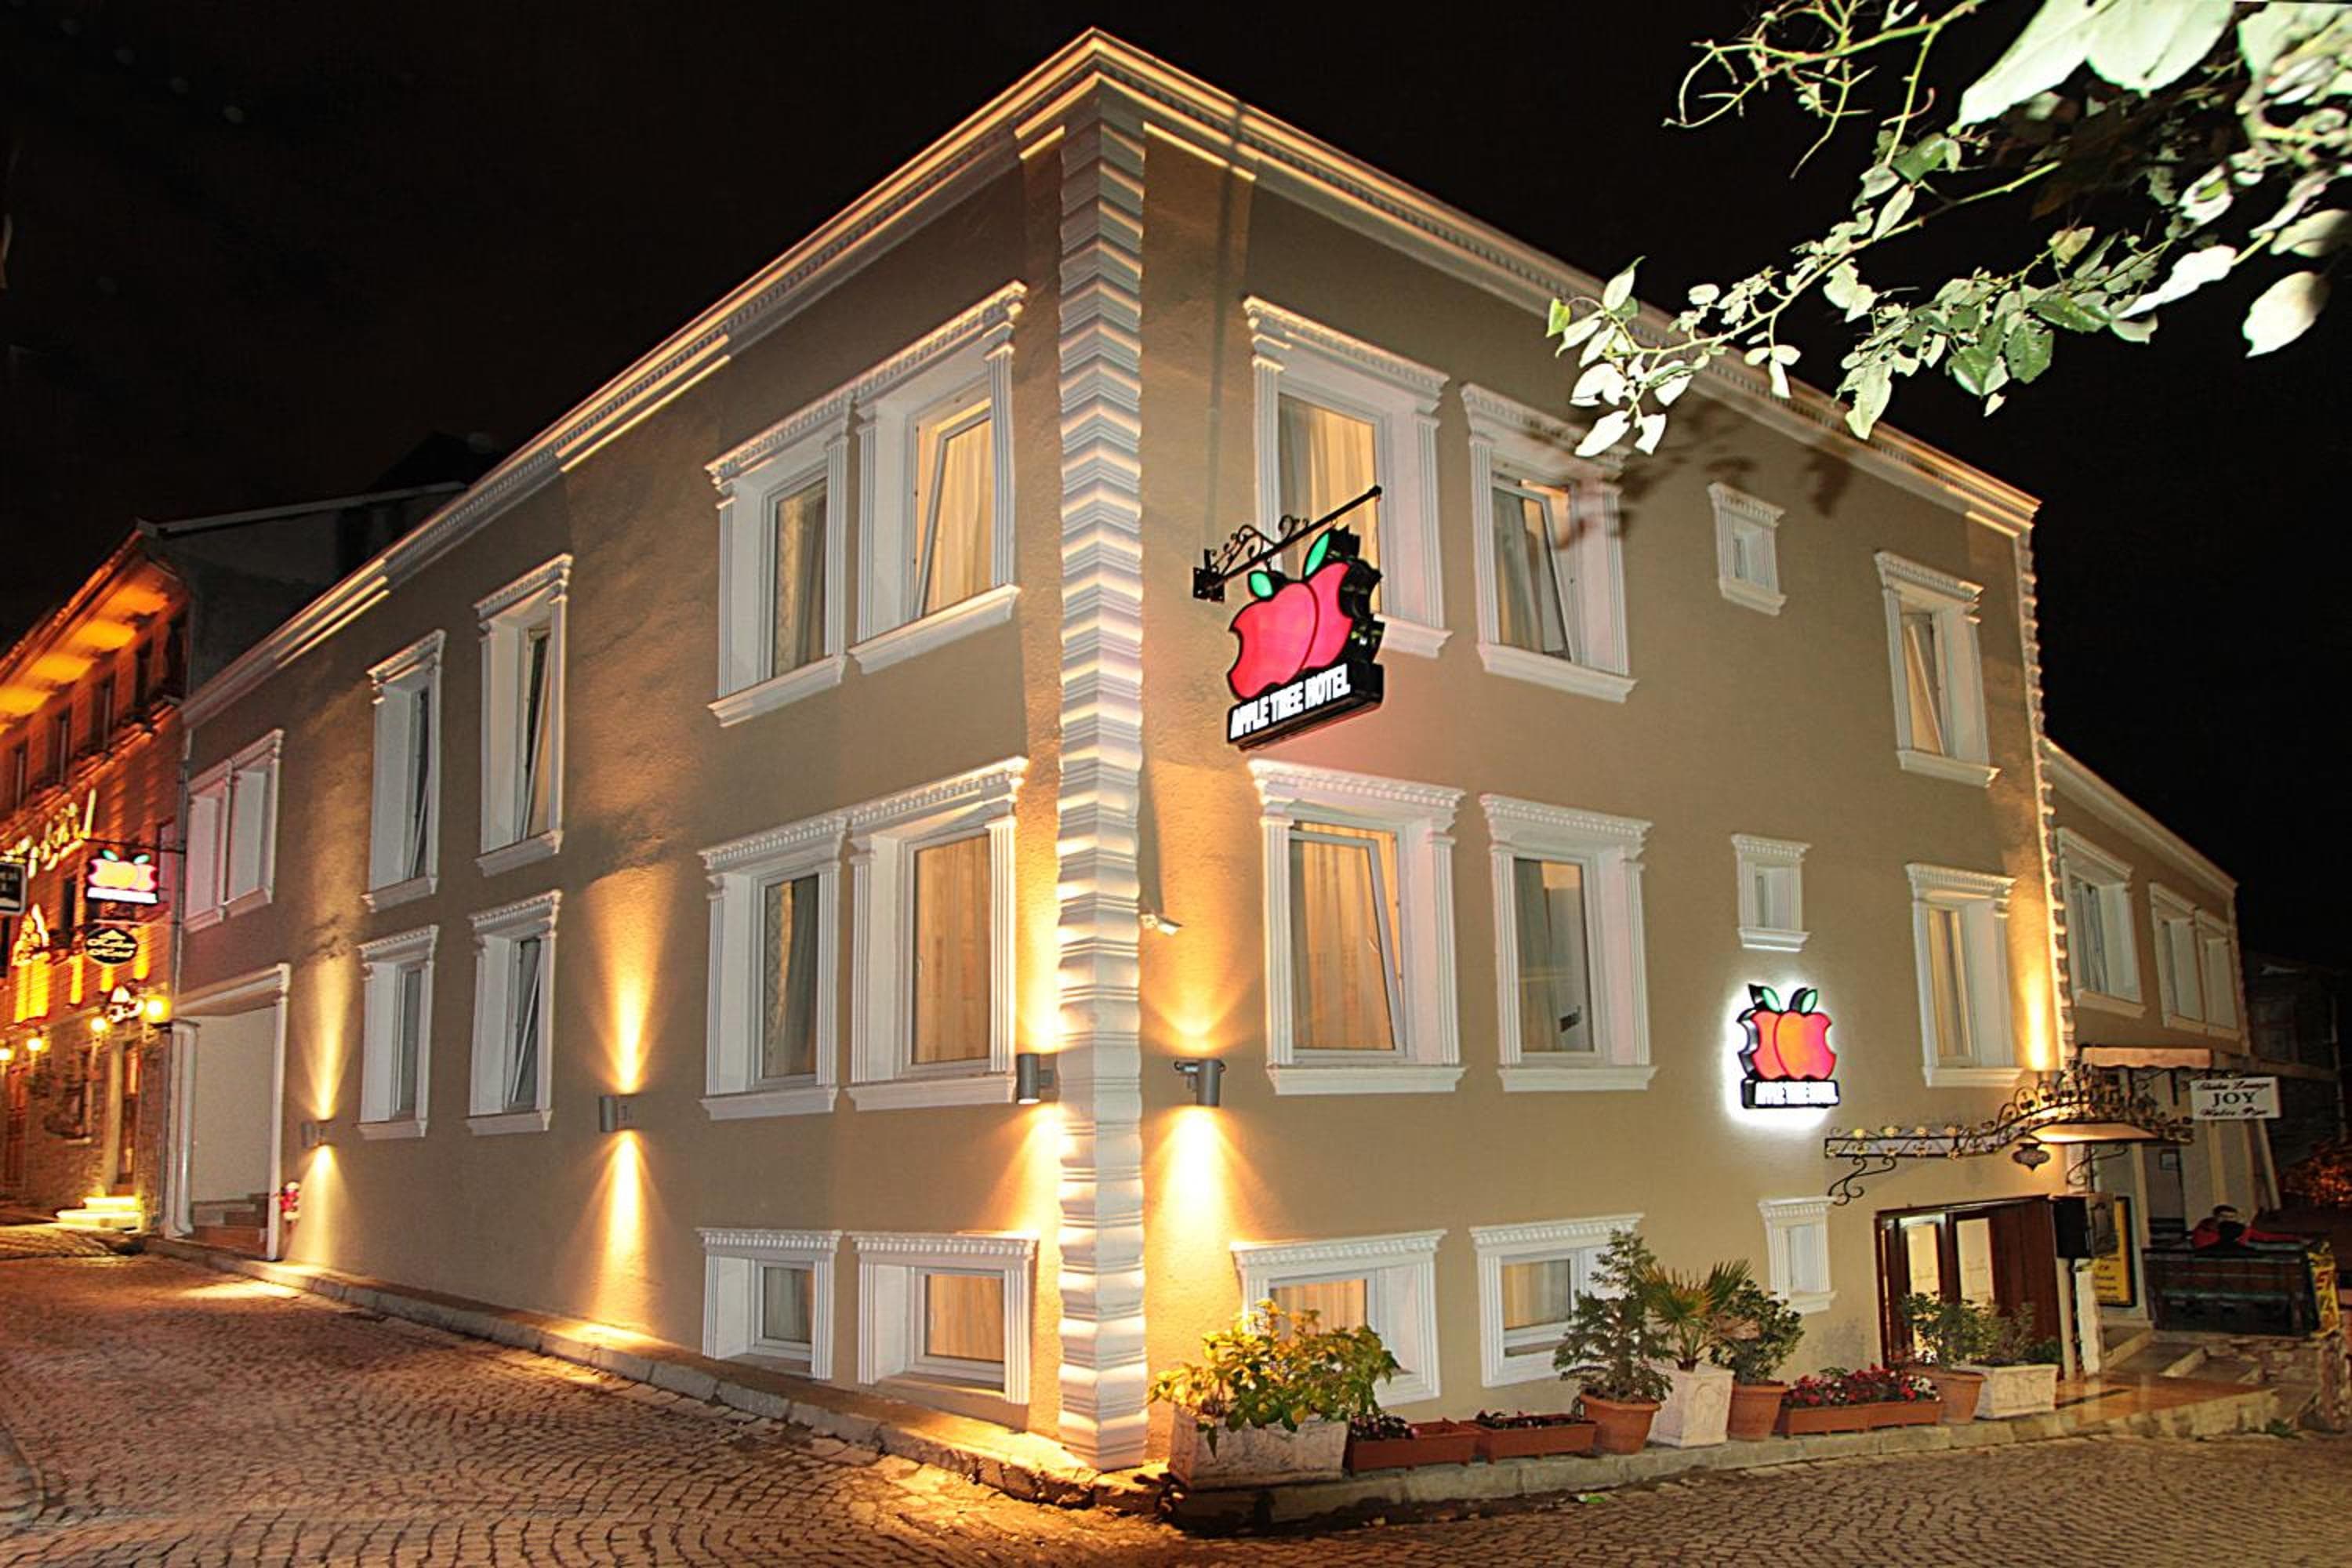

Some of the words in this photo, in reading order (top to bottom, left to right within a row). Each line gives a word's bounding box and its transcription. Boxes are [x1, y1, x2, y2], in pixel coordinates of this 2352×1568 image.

[1230, 695, 1269, 739] APPLE
[1270, 681, 1304, 722] TREE
[1305, 662, 1352, 710] HOTEL
[2212, 1092, 2256, 1108] JOY
